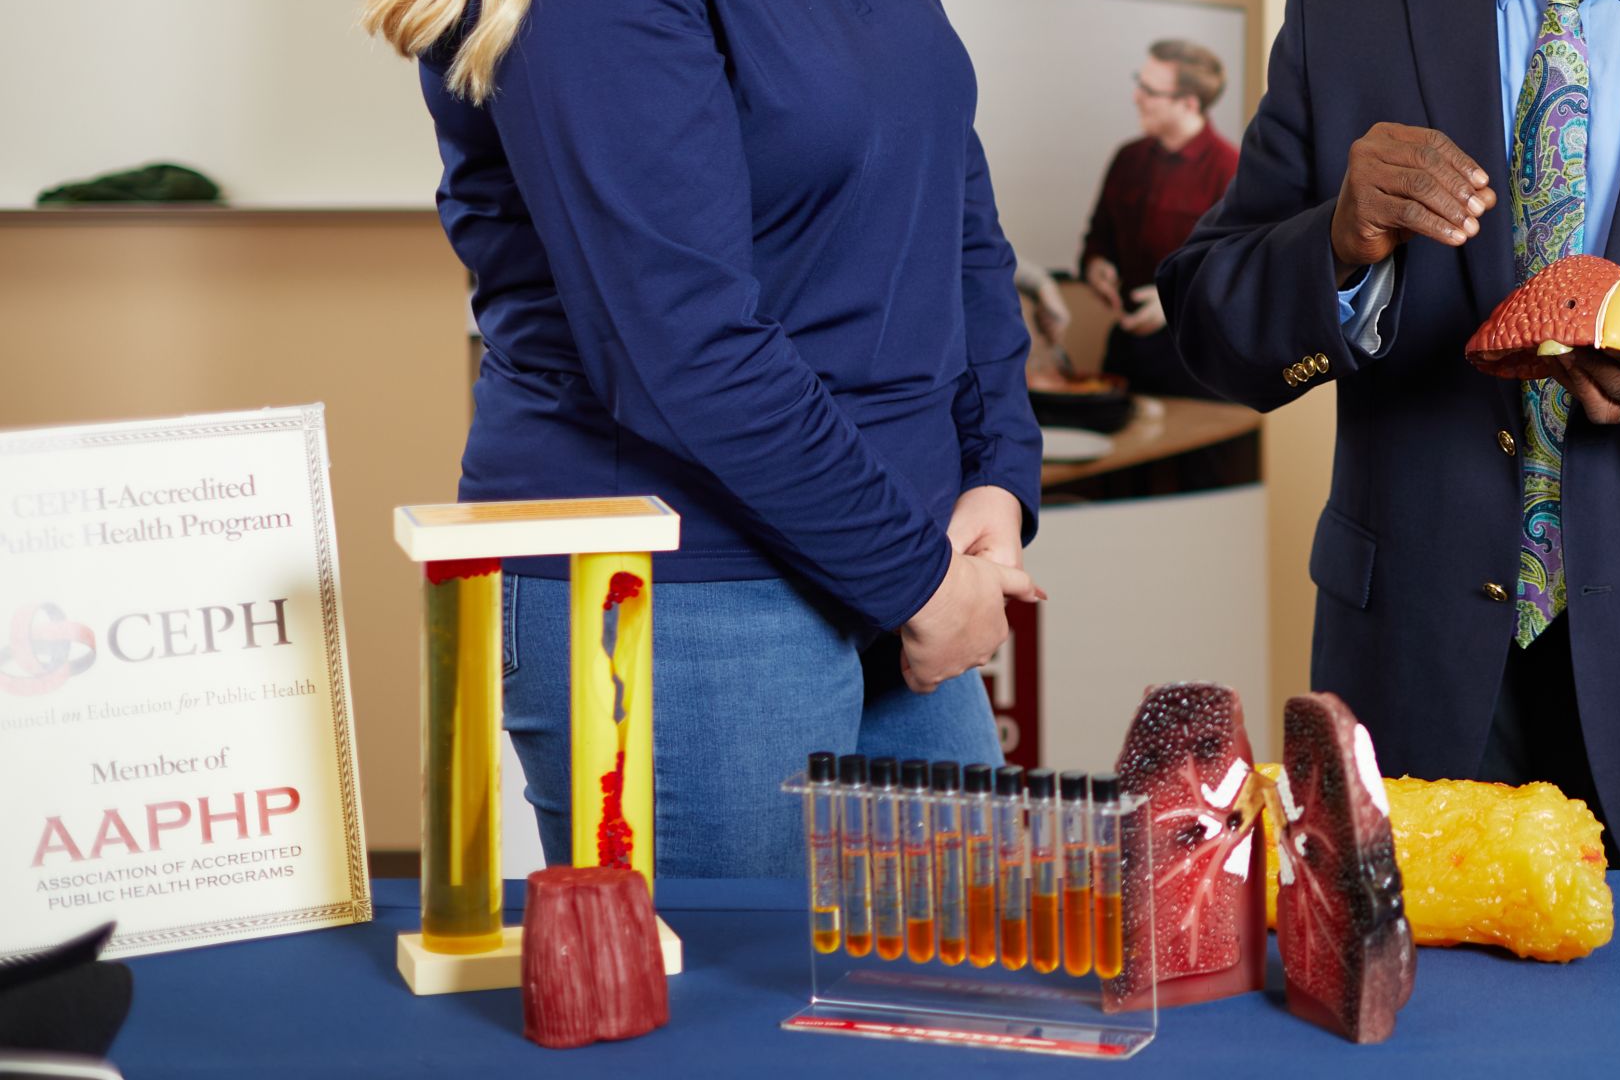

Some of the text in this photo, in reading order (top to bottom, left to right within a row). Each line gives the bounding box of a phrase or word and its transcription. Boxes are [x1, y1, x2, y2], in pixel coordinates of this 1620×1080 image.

[11, 474, 257, 519] CEPH-Accredited
[82, 516, 174, 547] Health
[179, 510, 293, 542] Program
[107, 598, 293, 663] CEPH
[0, 678, 318, 731] ouncil on Education for Public Health
[90, 747, 231, 785] Member of
[30, 786, 301, 868] AAPHP
[36, 844, 303, 893] ASSOCIATION OF ACCREDITED
[48, 865, 296, 910] PUBLIC HEALTH PROGRAMS
